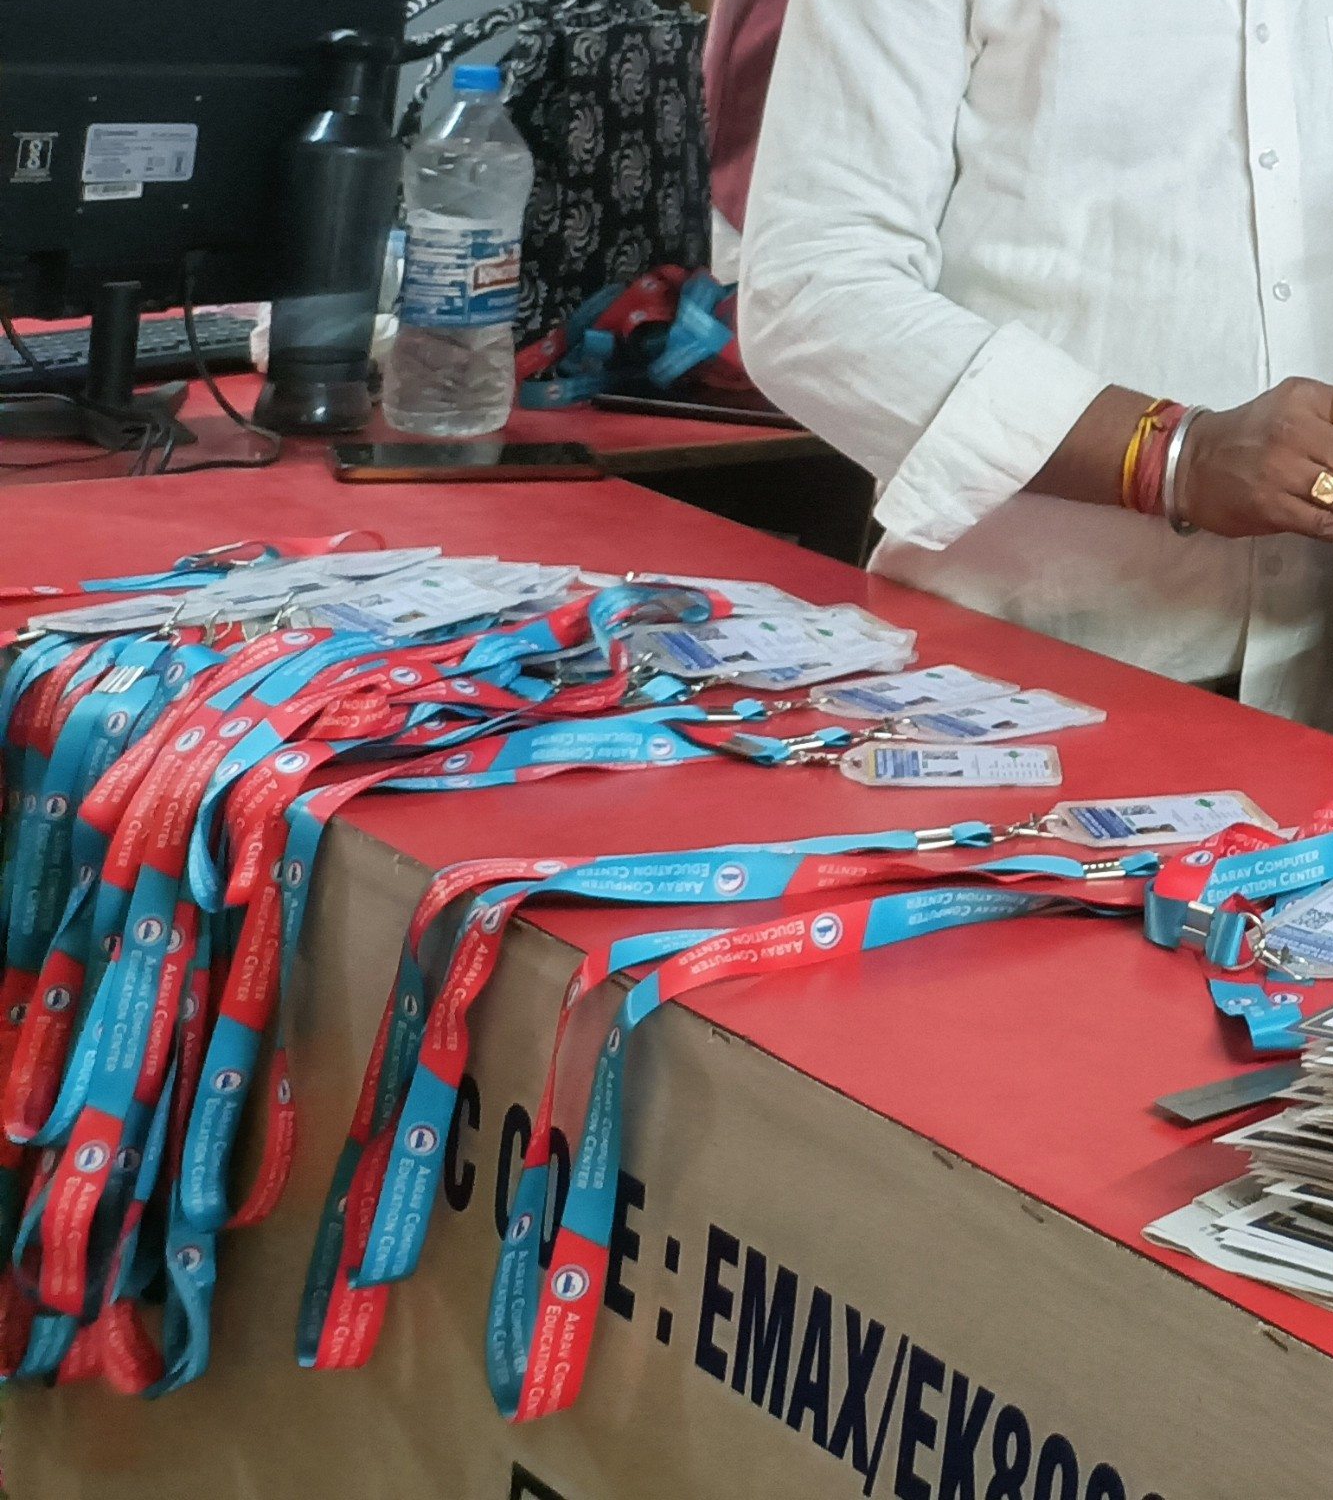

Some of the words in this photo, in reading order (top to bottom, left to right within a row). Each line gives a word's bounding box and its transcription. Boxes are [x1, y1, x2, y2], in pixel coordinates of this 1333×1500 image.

[1254, 850, 1320, 873] COMPUTER
[1278, 864, 1326, 884] CENTER
[731, 920, 807, 947] EDUCATION
[691, 946, 759, 975] COMPUTER
[762, 938, 805, 961] AARAV
[535, 1303, 562, 1384] EDUCATION
[557, 1311, 580, 1360] AARAV
